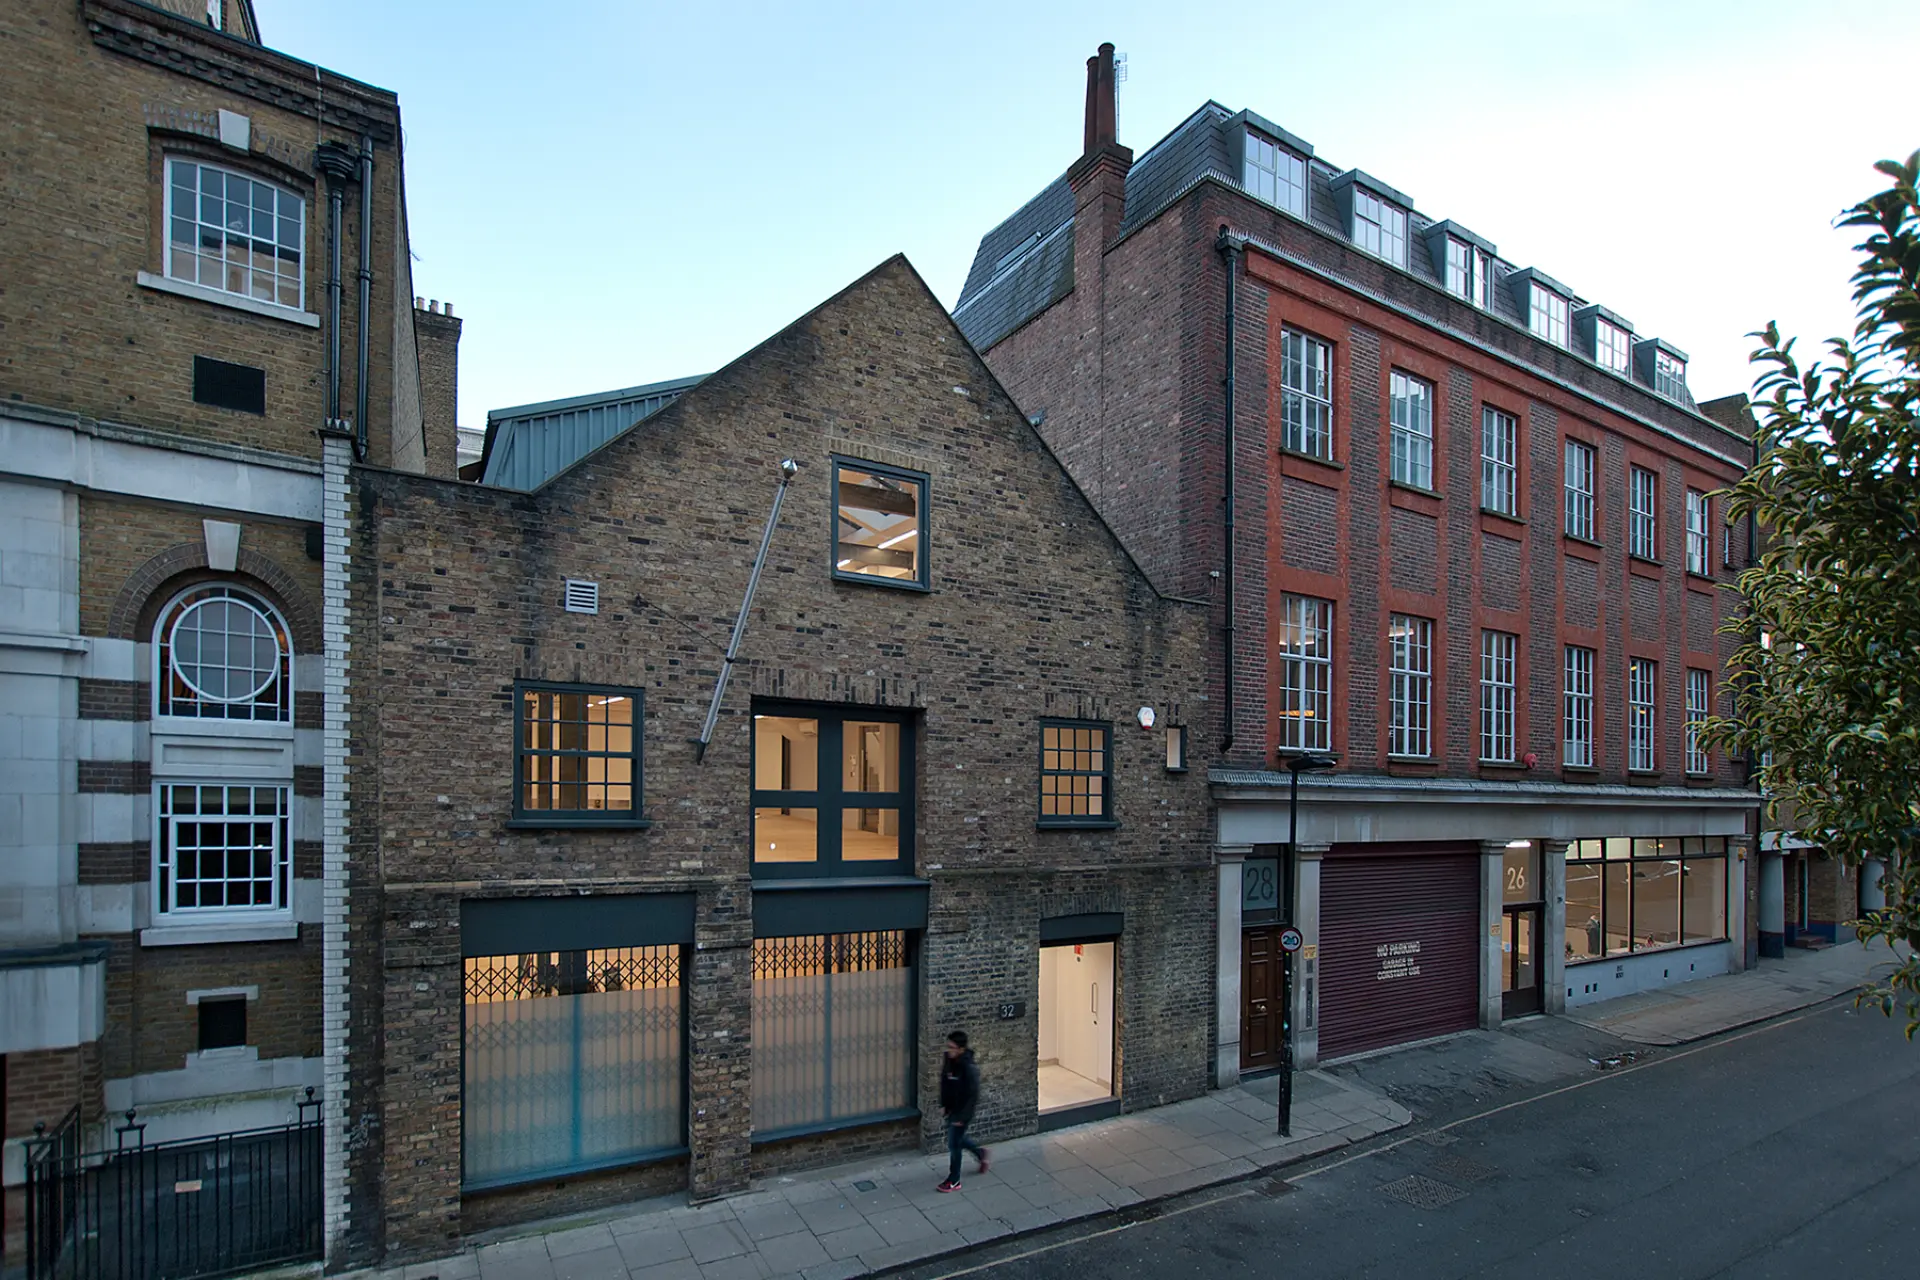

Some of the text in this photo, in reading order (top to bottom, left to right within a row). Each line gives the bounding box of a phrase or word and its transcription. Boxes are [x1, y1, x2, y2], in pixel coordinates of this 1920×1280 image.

[1246, 866, 1274, 901] 28
[1507, 866, 1526, 890] 26
[1282, 934, 1300, 946] 20
[1376, 941, 1420, 957] NO PARKING
[1001, 1004, 1014, 1017] 32
